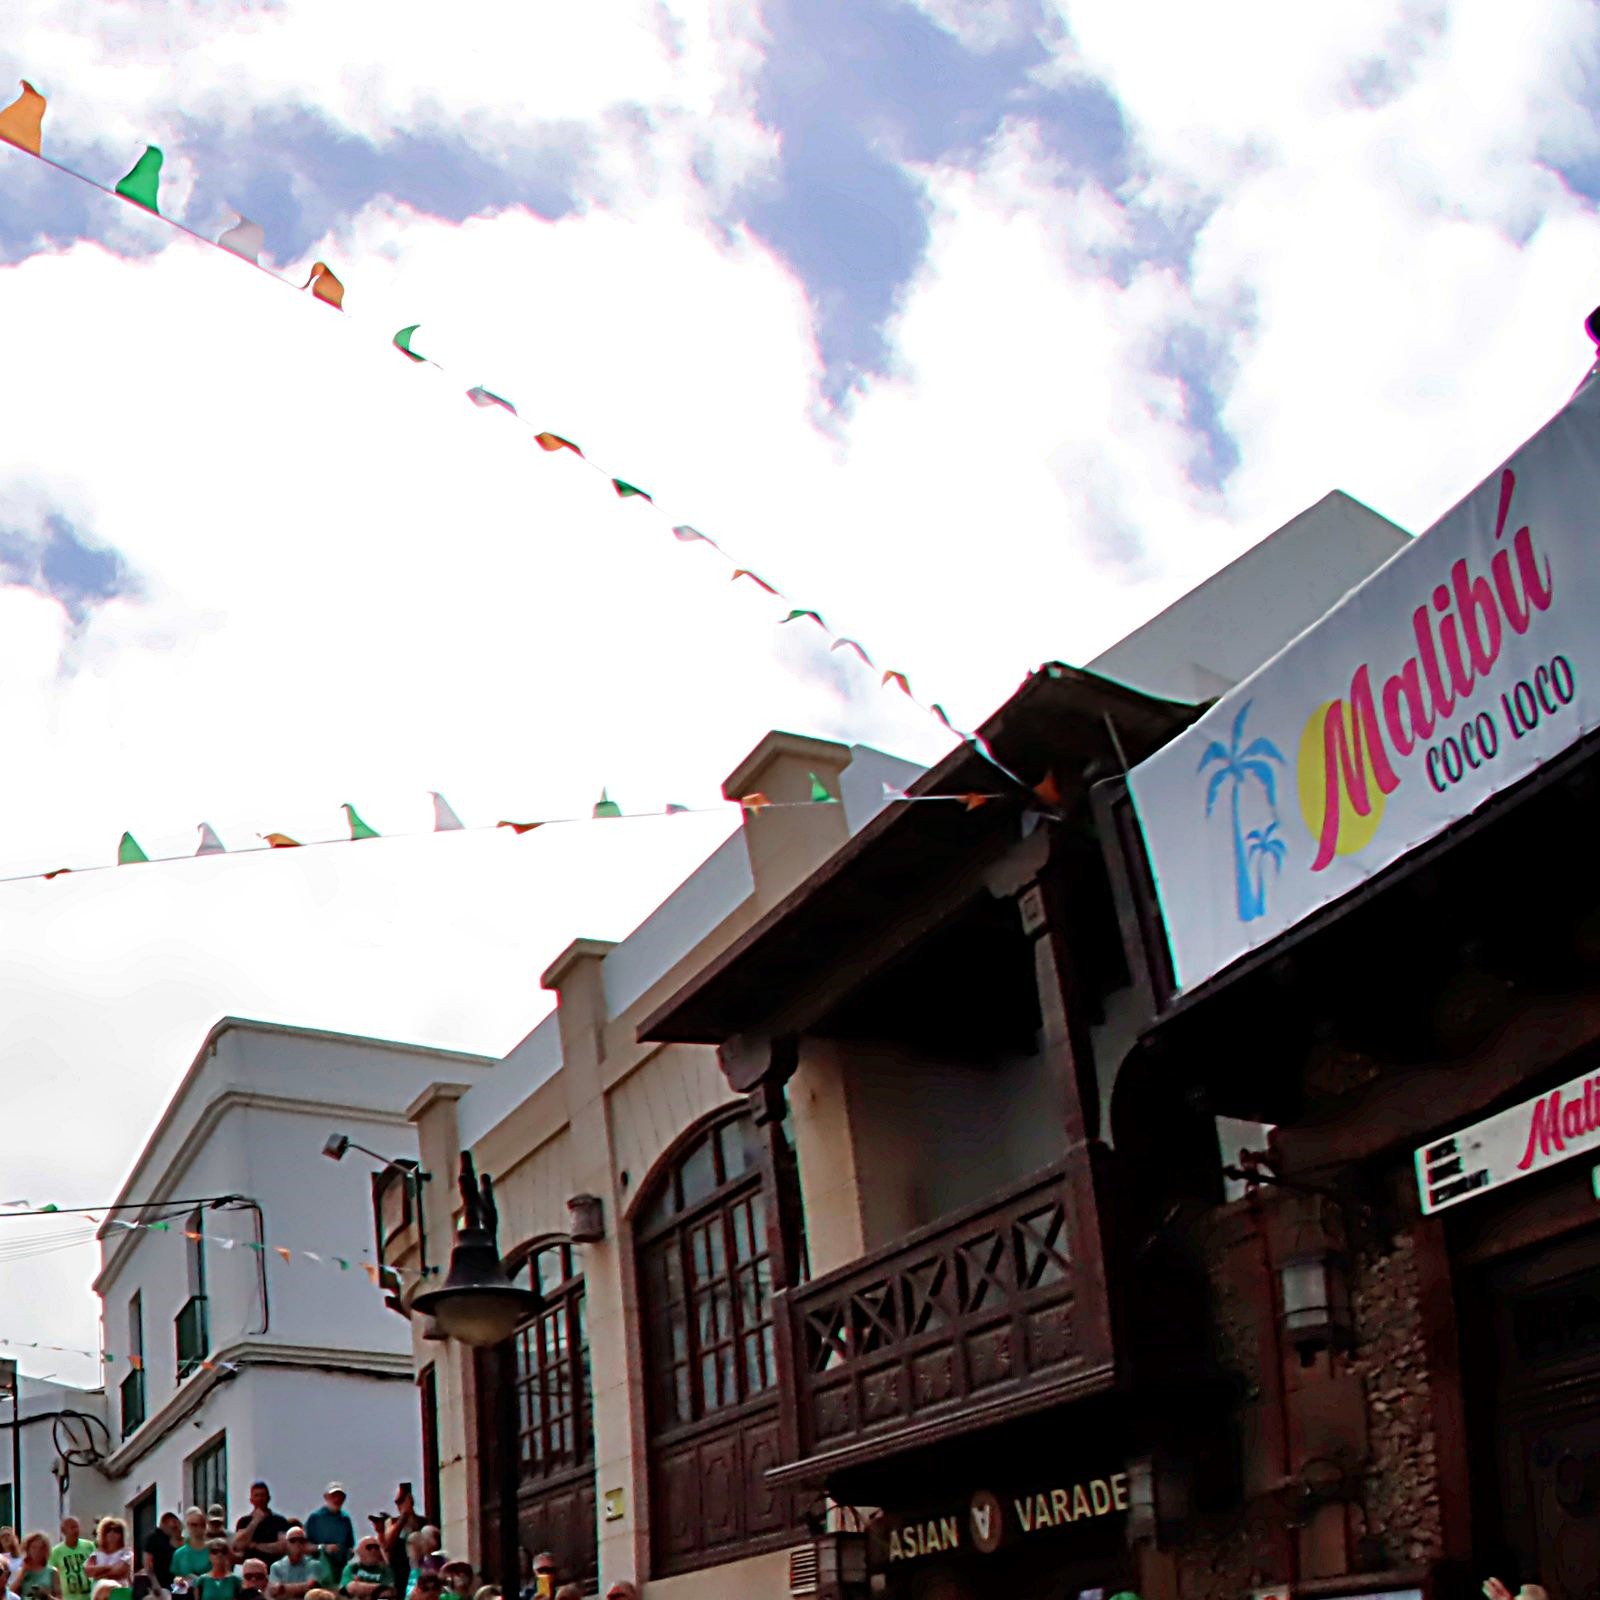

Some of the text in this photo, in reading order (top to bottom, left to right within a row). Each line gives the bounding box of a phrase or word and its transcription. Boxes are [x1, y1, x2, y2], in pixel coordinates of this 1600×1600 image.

[1310, 468, 1553, 872] Malibú
[1425, 654, 1576, 793] COCO LOCO
[889, 1516, 960, 1562] ASIAN
